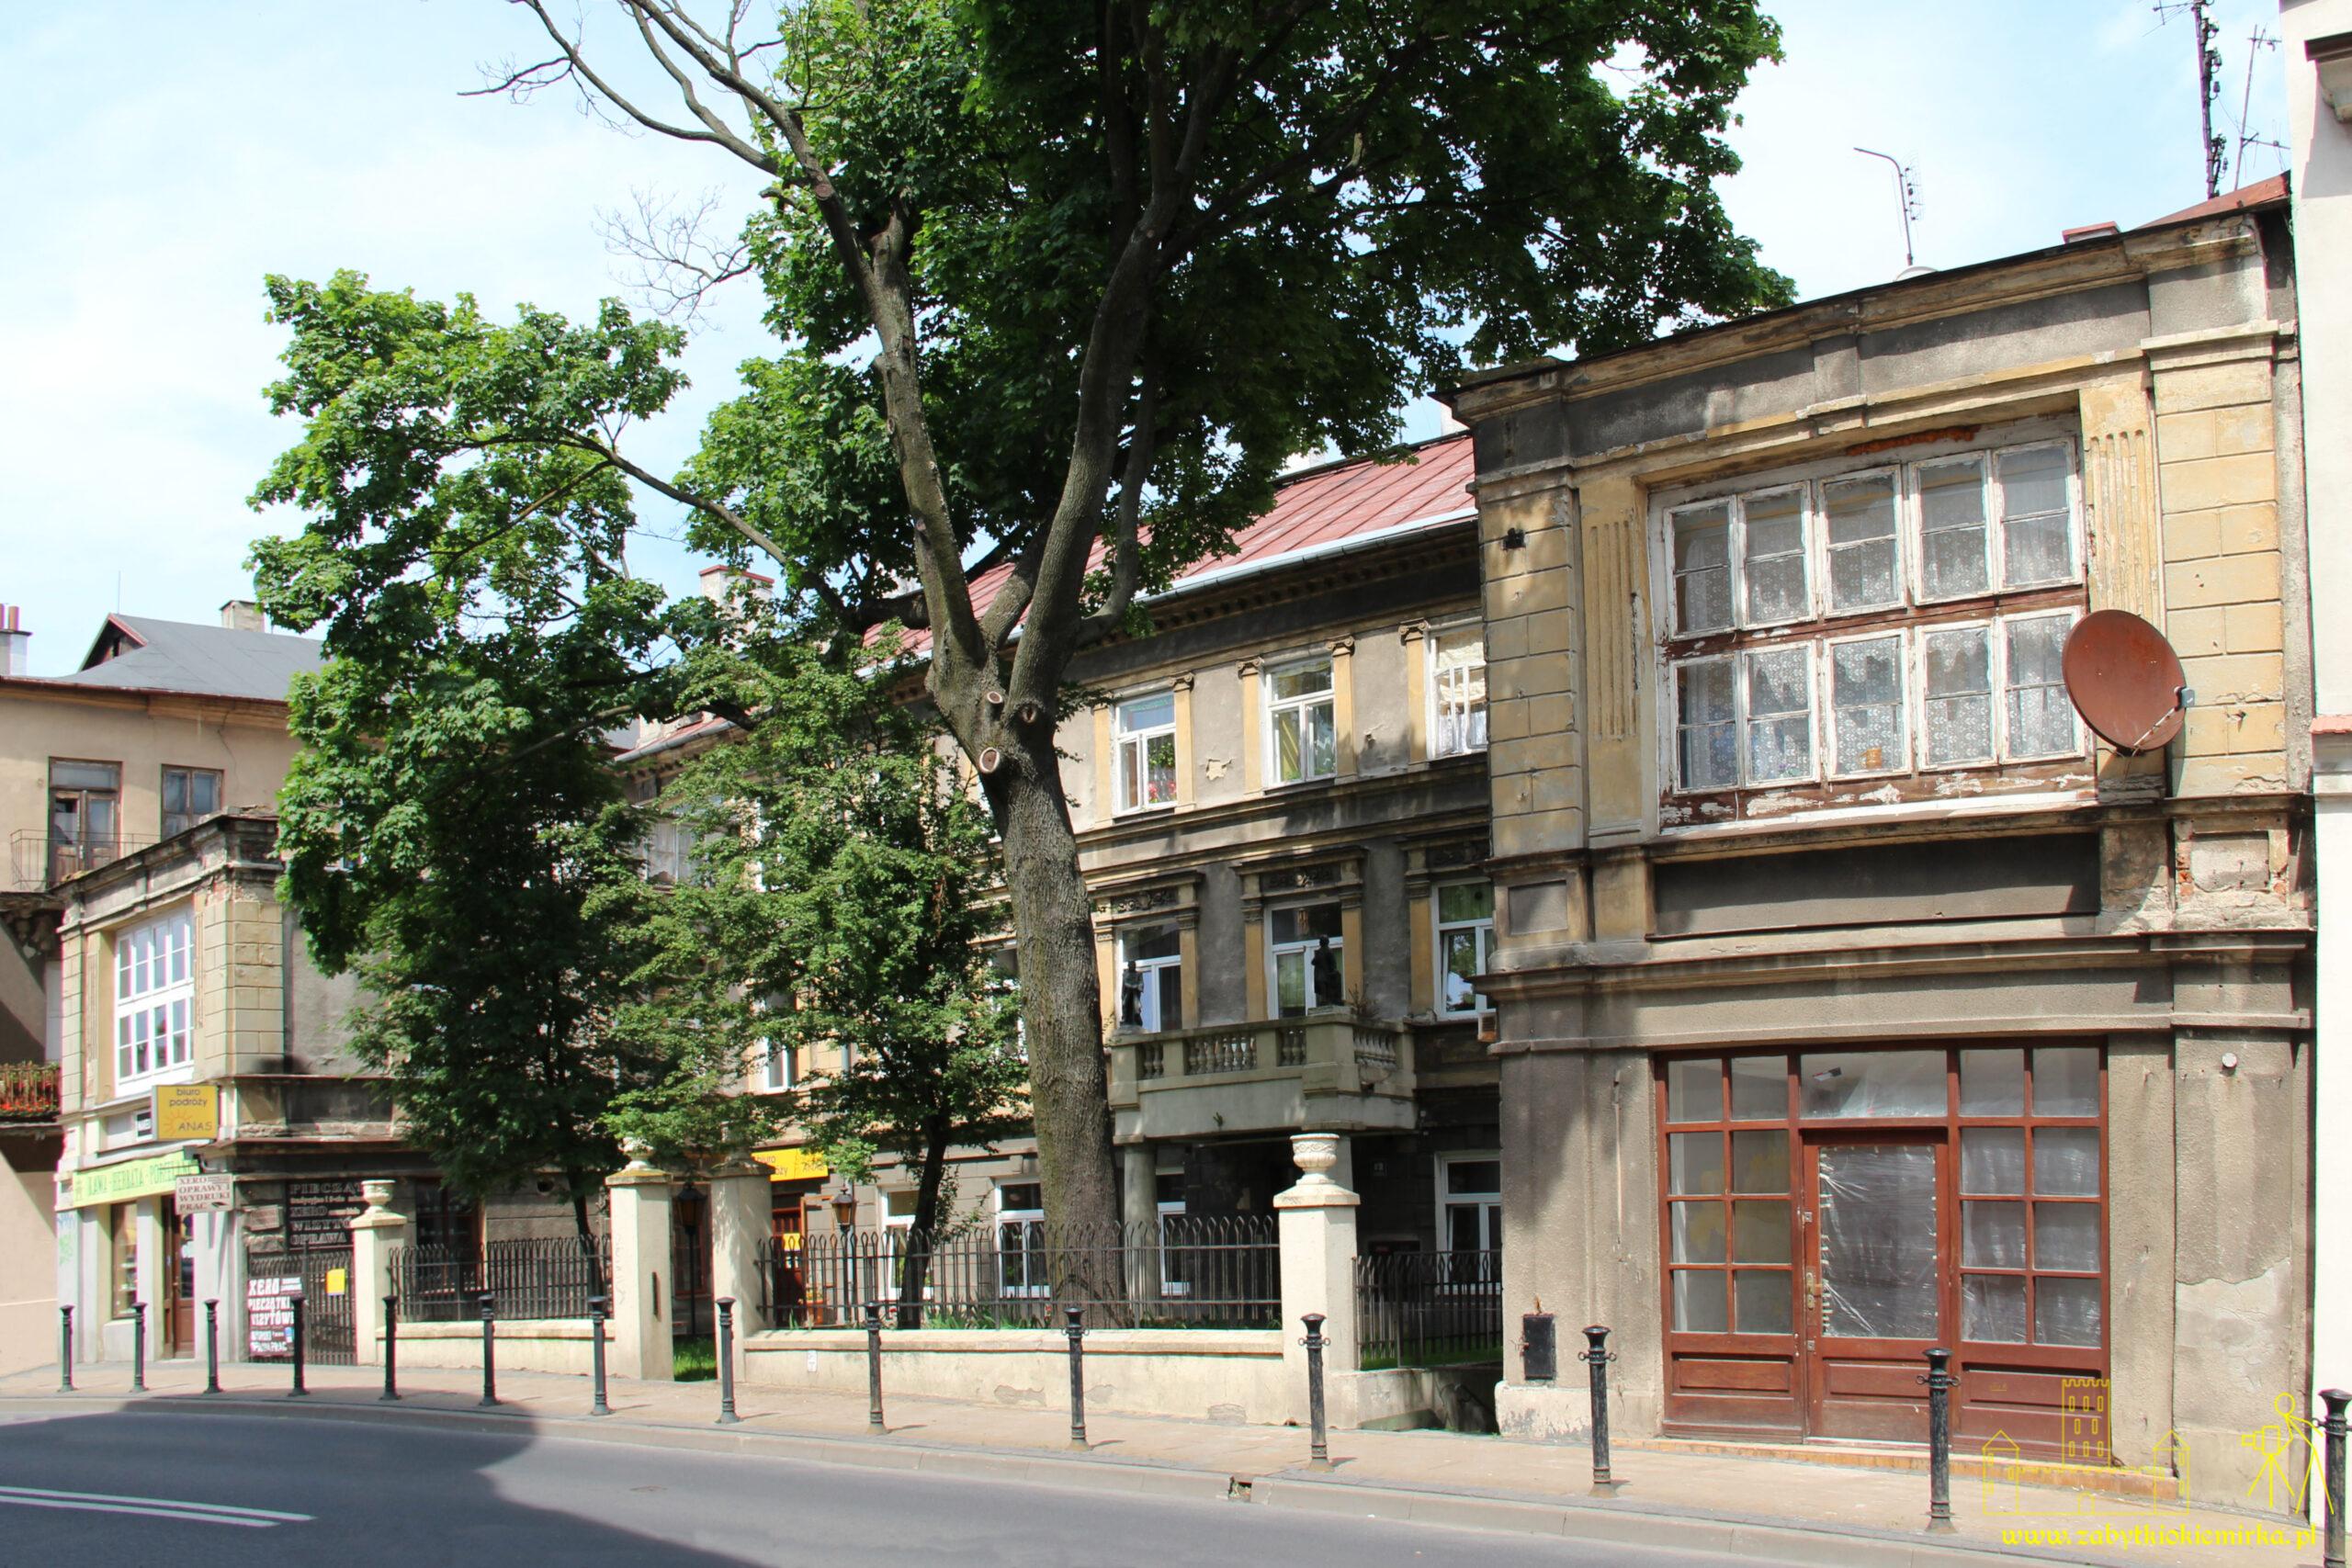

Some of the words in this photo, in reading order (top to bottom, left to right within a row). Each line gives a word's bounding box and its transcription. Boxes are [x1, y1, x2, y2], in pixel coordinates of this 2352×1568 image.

[178, 1121, 212, 1132] ANAS
[179, 1177, 207, 1185] XERO
[179, 1184, 221, 1193] OPRAWY
[289, 1182, 362, 1194] PIECZĄT
[179, 1192, 230, 1201] WYDRUKI
[290, 1216, 351, 1232] WIZYTÓ
[249, 1278, 279, 1296] XERO
